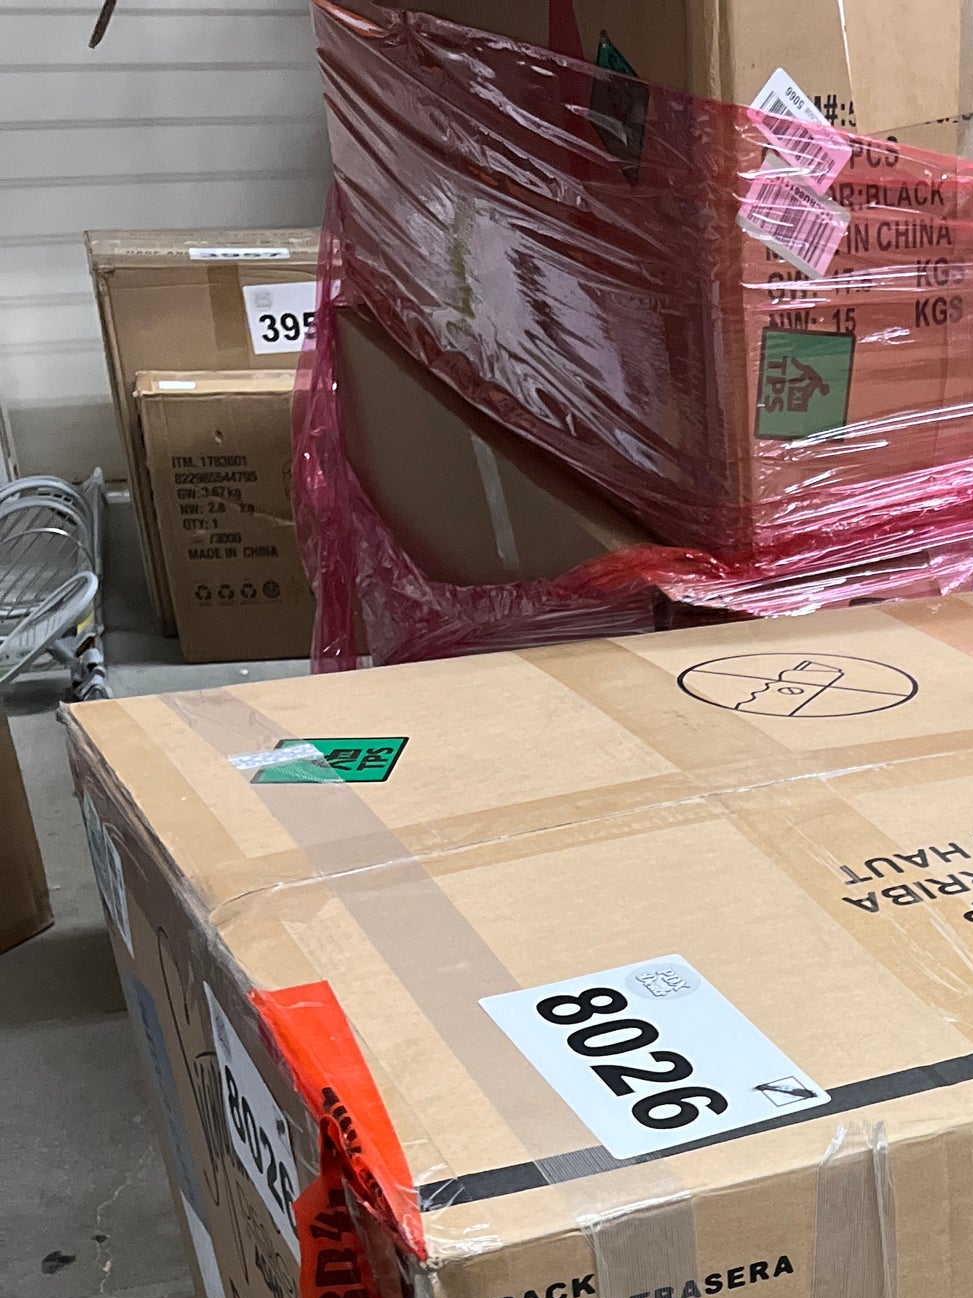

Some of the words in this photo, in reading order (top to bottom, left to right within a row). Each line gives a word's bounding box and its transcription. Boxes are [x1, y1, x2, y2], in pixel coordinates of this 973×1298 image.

[847, 222, 870, 253] IN
[876, 217, 952, 252] CHINA
[916, 256, 965, 289] KGS
[832, 307, 857, 333] 15
[914, 295, 964, 328] KGS
[764, 355, 788, 414] TPS
[188, 548, 222, 560] MADE
[225, 547, 237, 559] IN
[243, 545, 279, 558] CHINA
[356, 747, 395, 772] TPS
[839, 842, 971, 885] HAUT
[536, 987, 729, 1130] 8026
